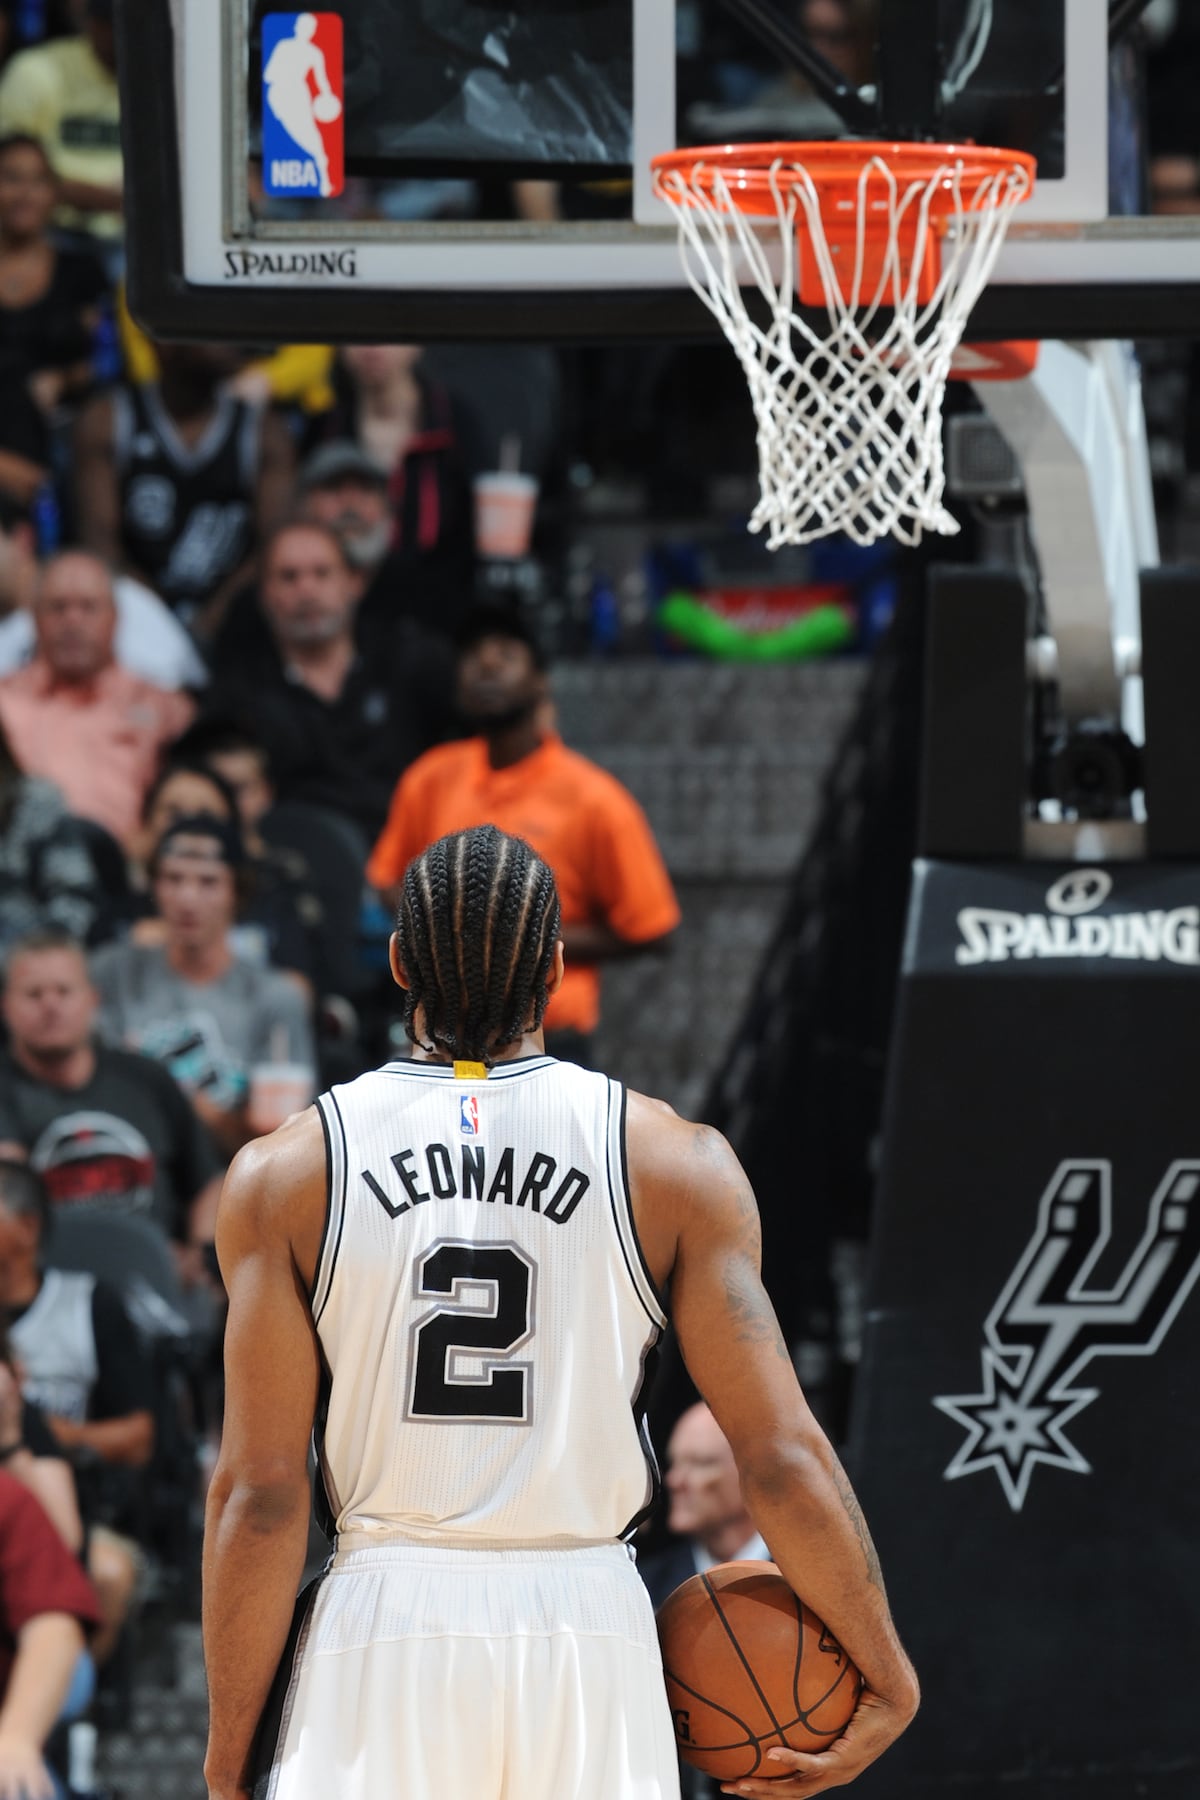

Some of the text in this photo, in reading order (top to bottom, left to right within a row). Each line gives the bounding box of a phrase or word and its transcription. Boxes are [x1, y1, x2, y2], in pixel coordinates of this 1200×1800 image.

[271, 160, 318, 187] NBA
[225, 249, 356, 279] SPALDING
[955, 906, 1200, 966] SPALDING
[361, 1143, 590, 1225] LEONARD
[402, 1237, 538, 1426] 2
